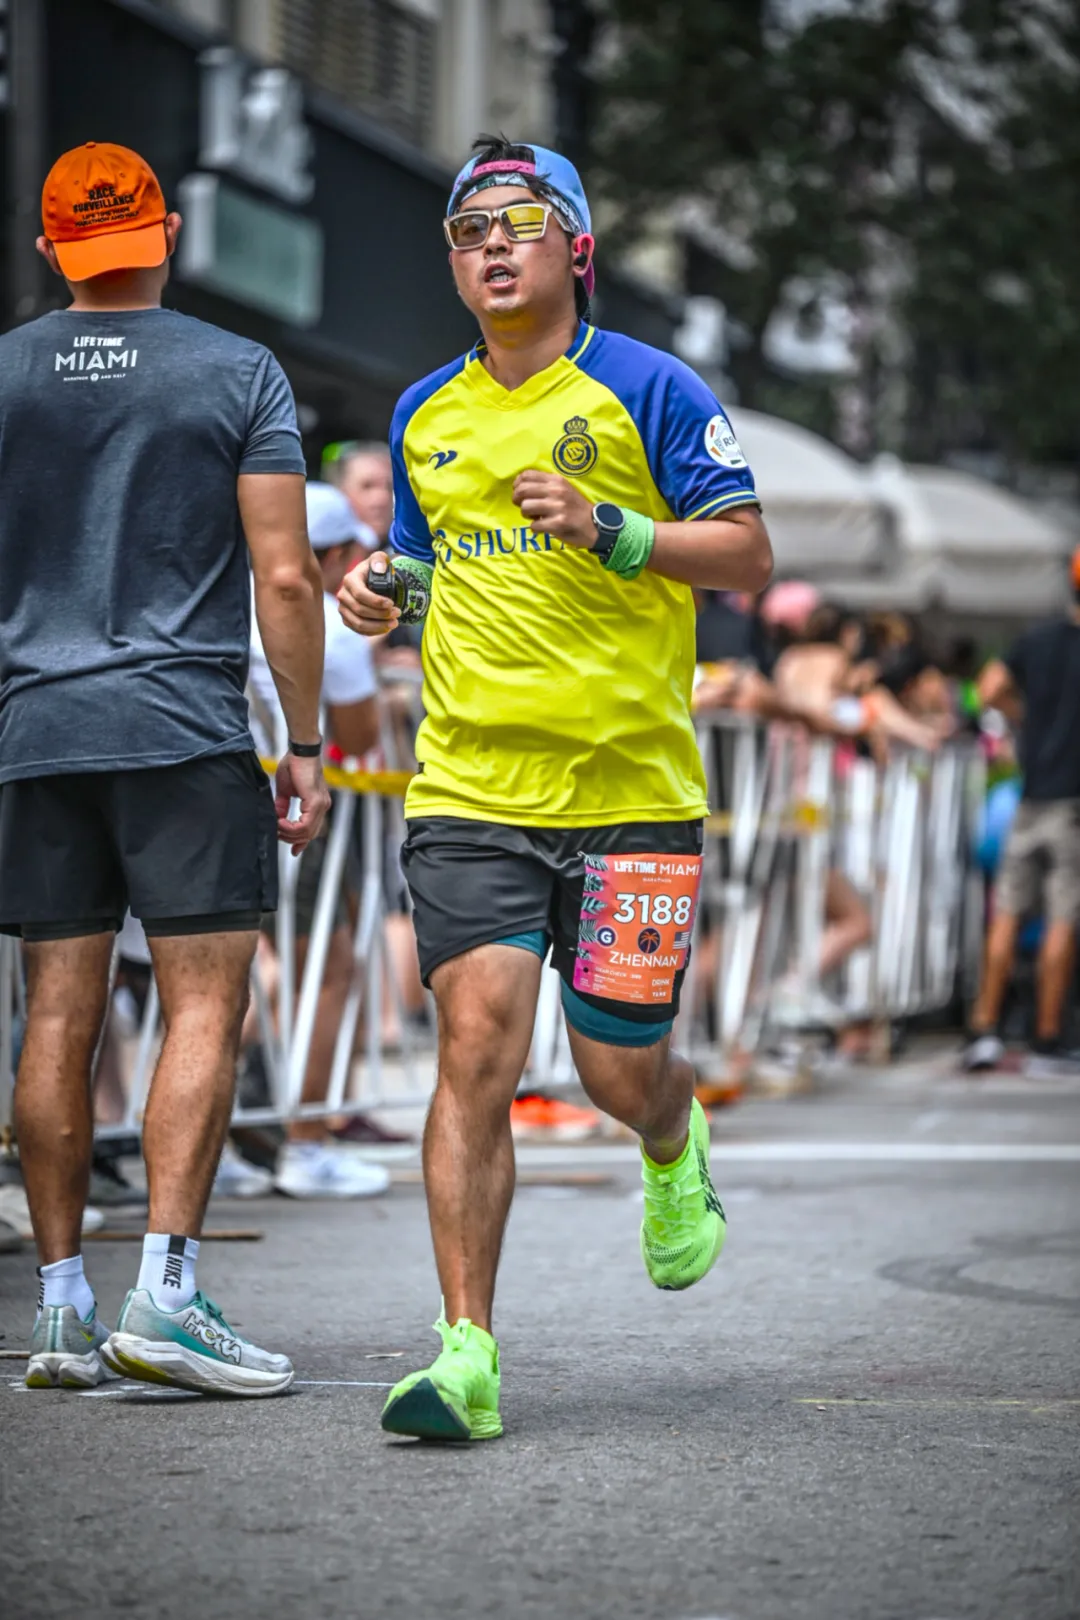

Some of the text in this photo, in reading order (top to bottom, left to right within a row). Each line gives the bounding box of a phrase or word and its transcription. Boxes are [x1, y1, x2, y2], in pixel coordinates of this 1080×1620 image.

[88, 185, 116, 200] RACE
[73, 194, 135, 213] SURVEILLANCE
[75, 217, 110, 228] MARATHON
[54, 349, 138, 371] MIAMI
[659, 864, 700, 876] MIAMI
[612, 892, 692, 926] 3188
[600, 930, 613, 945] G
[609, 950, 678, 967] ZHENNAN
[163, 1256, 184, 1289] NIKE
[182, 1312, 243, 1365] HOKA
